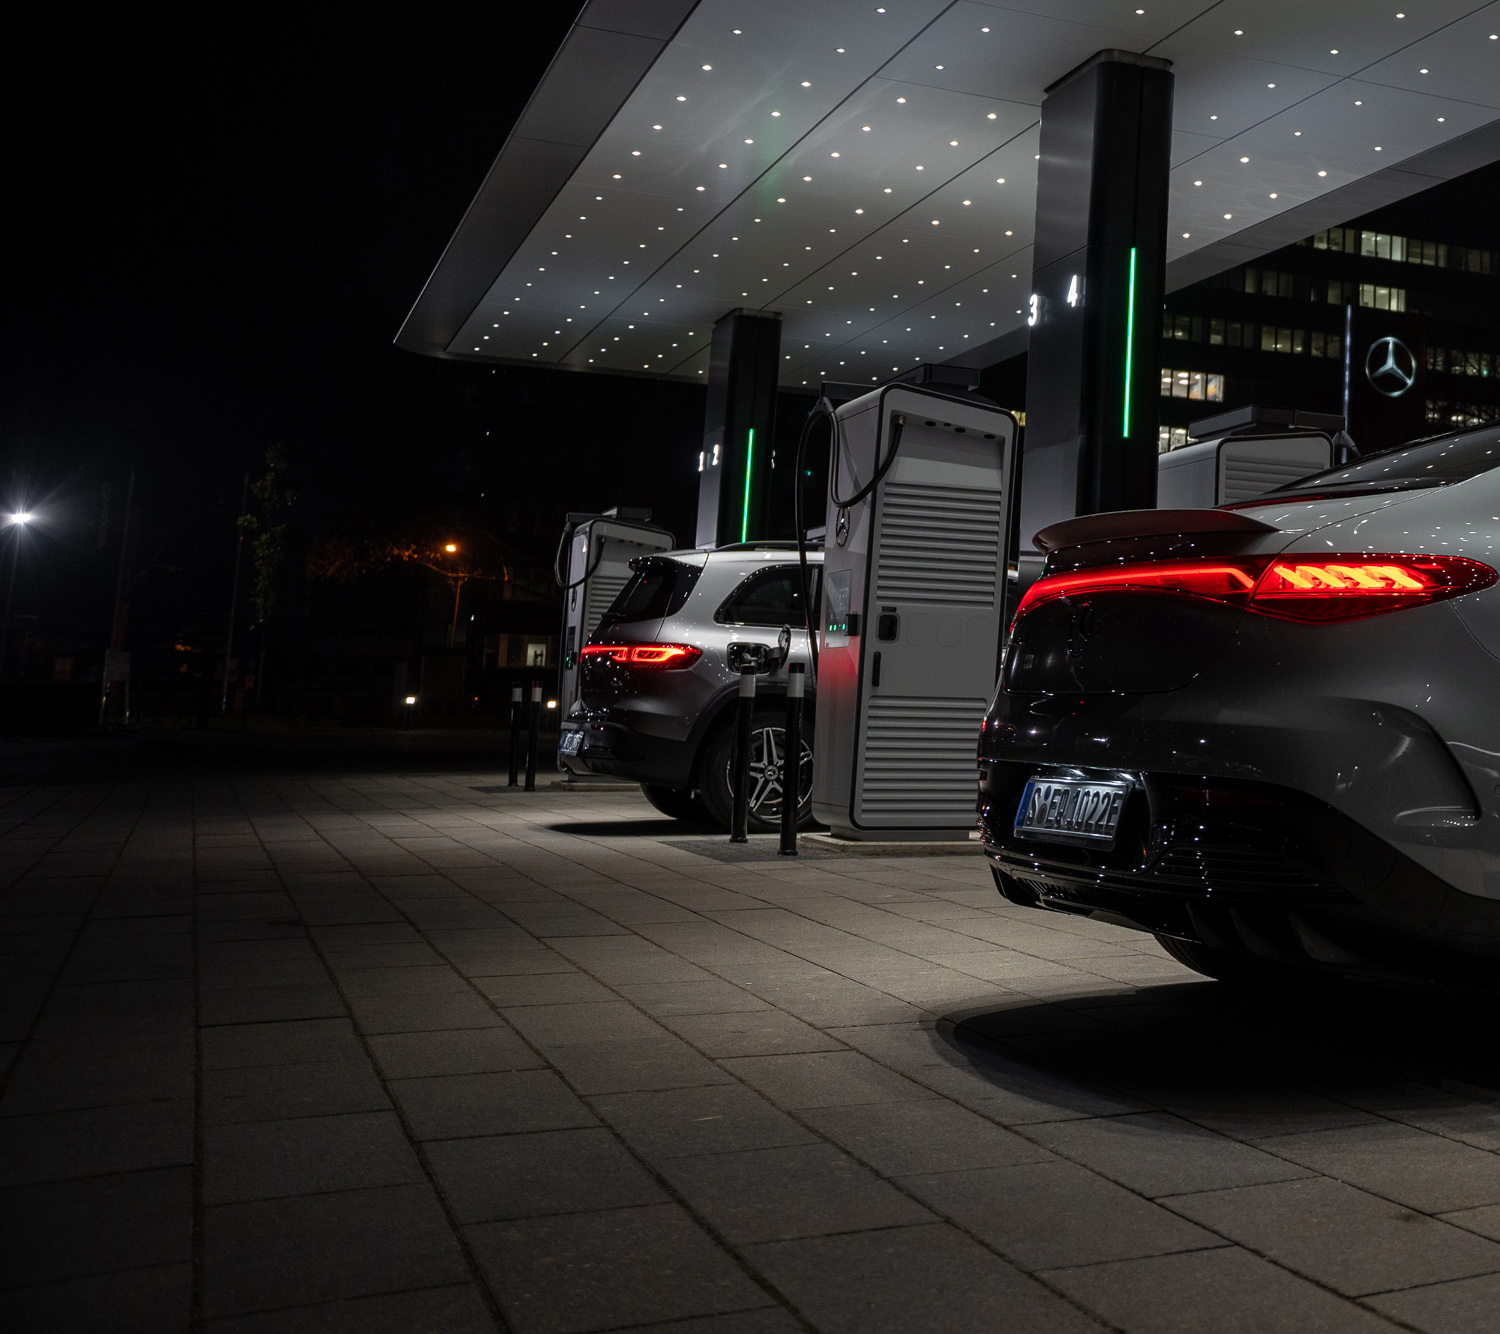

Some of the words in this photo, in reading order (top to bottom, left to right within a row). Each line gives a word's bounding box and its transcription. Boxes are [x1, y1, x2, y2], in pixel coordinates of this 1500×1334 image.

[1028, 293, 1038, 326] 3
[1067, 274, 1078, 307] 4
[698, 451, 704, 472] 1
[712, 444, 720, 466] 2
[1026, 786, 1042, 826] S
